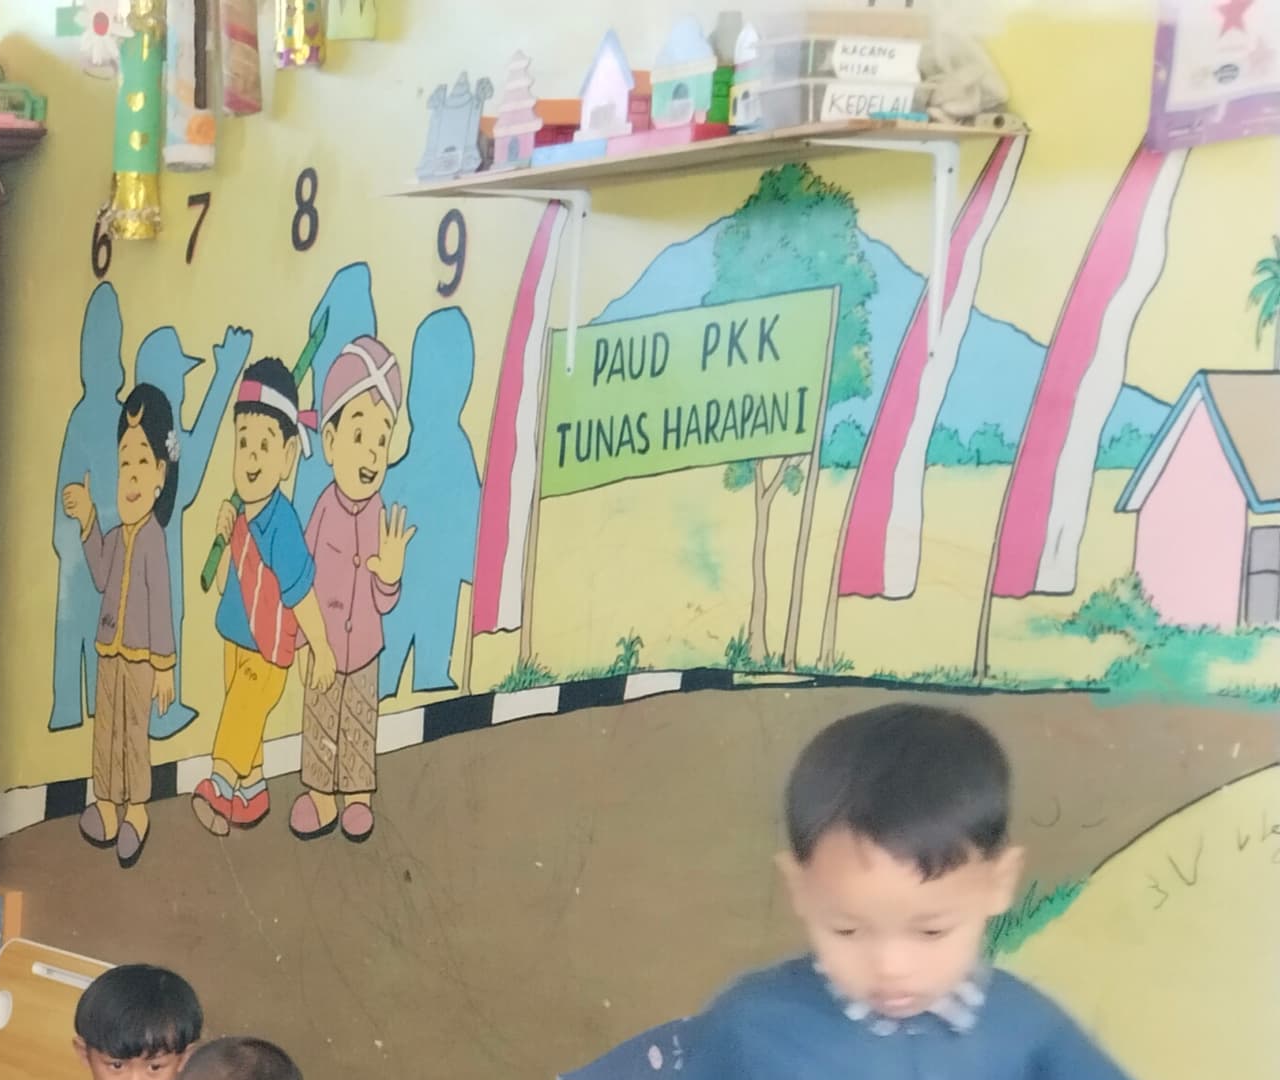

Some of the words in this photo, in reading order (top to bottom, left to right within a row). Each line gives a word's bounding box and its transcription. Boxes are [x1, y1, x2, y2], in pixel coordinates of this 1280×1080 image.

[840, 45, 896, 59] KACANG
[828, 95, 910, 115] KEDELAI
[91, 206, 113, 279] 6
[184, 191, 211, 265] 7
[290, 167, 319, 252] 8
[436, 207, 468, 298] 9
[593, 331, 670, 388] PAUD
[700, 313, 780, 372] PKK
[555, 411, 650, 468] TUNAS
